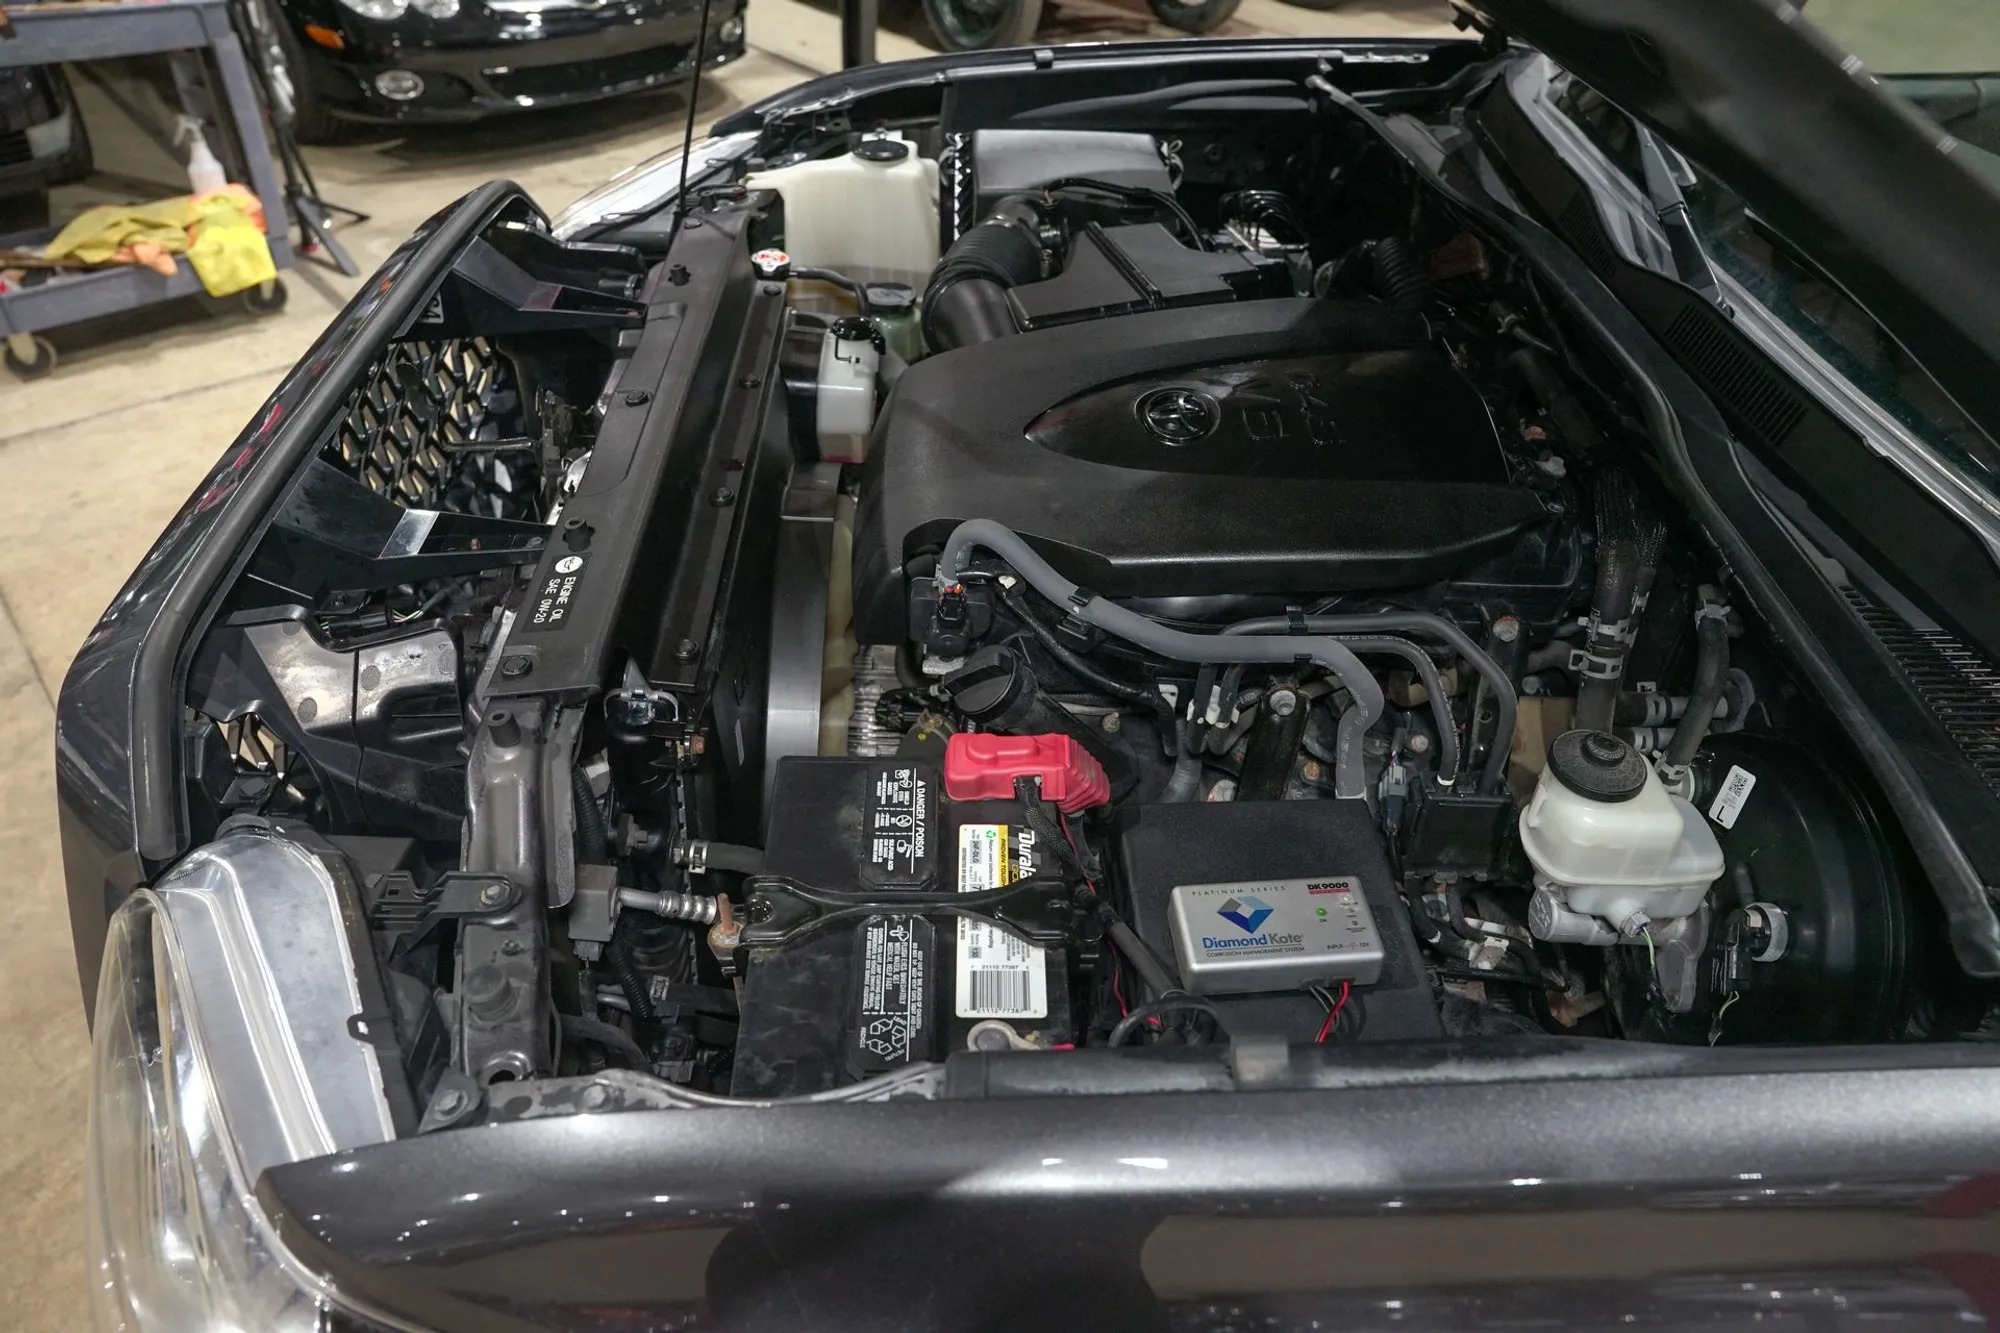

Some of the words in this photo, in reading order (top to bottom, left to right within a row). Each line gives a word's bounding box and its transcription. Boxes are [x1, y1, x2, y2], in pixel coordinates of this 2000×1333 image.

[545, 578, 561, 595] SAE
[556, 576, 577, 605] ENGINE
[533, 598, 553, 623] 0W-20
[548, 608, 564, 622] OIL
[916, 788, 926, 820] DANGER
[914, 827, 925, 858] POISON
[1018, 830, 1037, 880] Durala
[1191, 888, 1244, 897] PLATINUM
[1250, 885, 1287, 893] SERIES
[1307, 882, 1349, 890] DK9000
[901, 941, 909, 958] FLUSH
[1202, 934, 1268, 949] Diamond
[1268, 933, 1304, 945] Kote
[886, 941, 894, 963] MEDICAL
[1207, 949, 1242, 958] CORROSION
[1242, 947, 1284, 957] MANAGEMENT
[900, 958, 908, 971] EYES
[885, 977, 893, 990] FAST
[892, 973, 900, 984] GET
[899, 971, 907, 1005] IMMEDIATELY
[859, 1026, 867, 1049] RECYCLE
